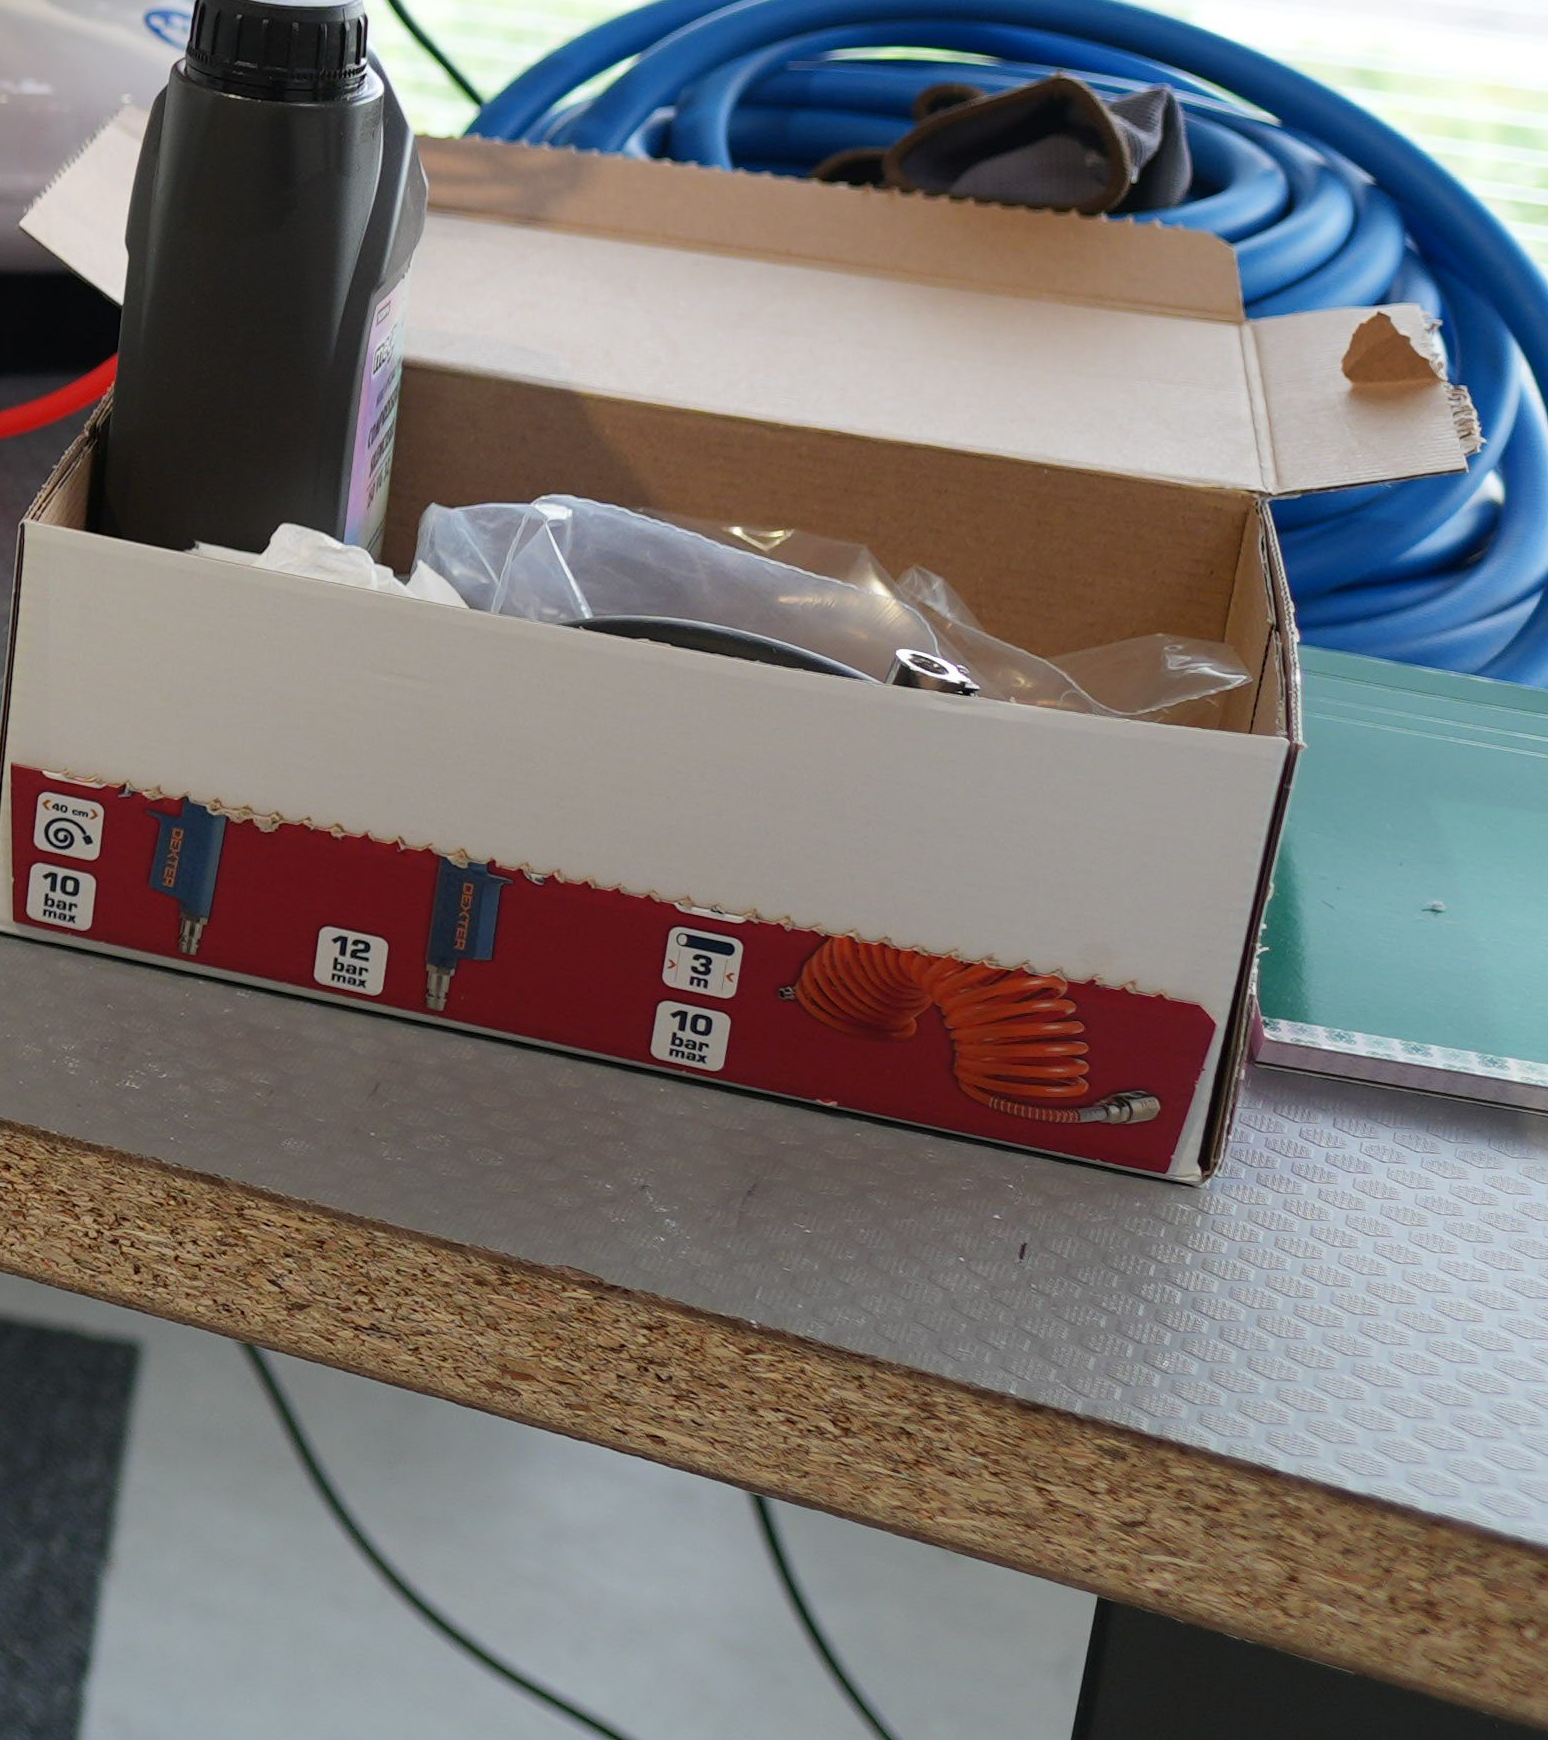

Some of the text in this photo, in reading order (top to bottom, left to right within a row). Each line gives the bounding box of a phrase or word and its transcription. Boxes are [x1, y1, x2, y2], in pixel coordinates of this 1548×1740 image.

[51, 802, 89, 818] 40 cm
[163, 827, 184, 888] DEXTER
[43, 871, 80, 898] 10
[43, 894, 78, 913] bar
[42, 908, 77, 924] max
[454, 882, 474, 950] DEXTER
[332, 935, 372, 962] 12
[333, 957, 369, 977] bar
[690, 954, 713, 976] 3
[331, 972, 367, 989] max
[689, 976, 709, 989] m
[670, 1010, 713, 1036] 10
[670, 1032, 709, 1052] bar
[668, 1048, 708, 1064] max
